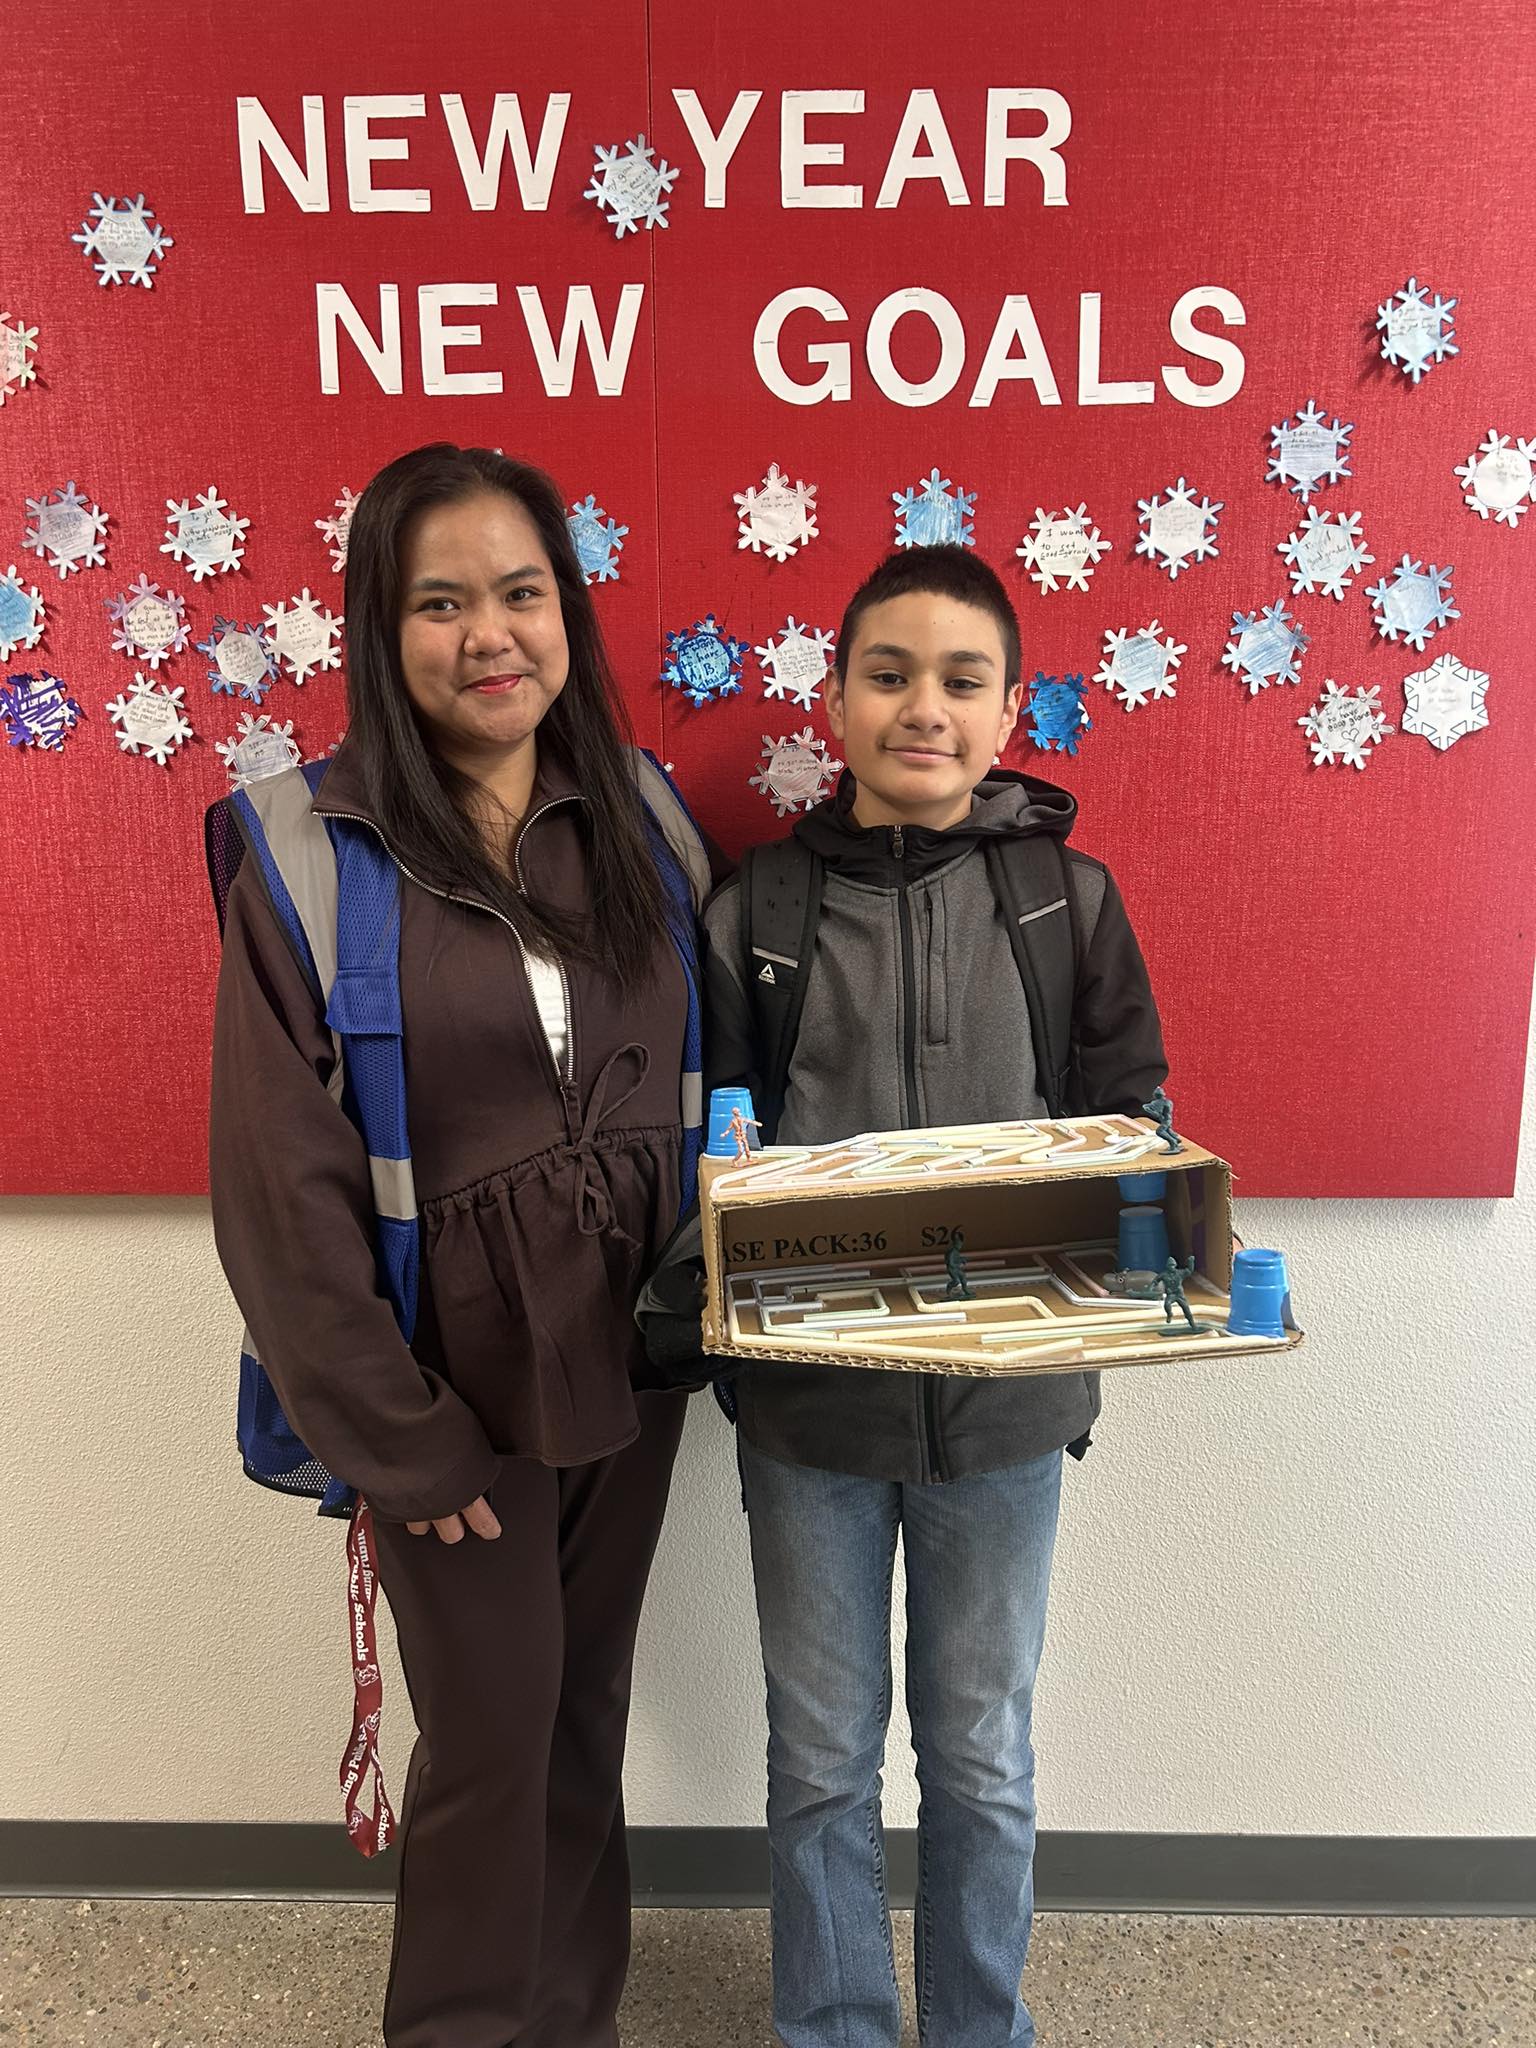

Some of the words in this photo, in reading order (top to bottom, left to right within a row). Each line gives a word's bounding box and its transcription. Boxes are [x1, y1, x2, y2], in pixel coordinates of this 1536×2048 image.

[237, 92, 571, 214] NEW
[672, 87, 1071, 209] YEAR
[316, 282, 644, 397] NEW
[753, 286, 1246, 407] GOALS
[1040, 543, 1052, 551] to
[1046, 528, 1053, 537] I
[1060, 525, 1084, 537] want
[691, 638, 716, 652] want
[680, 660, 694, 670] to
[773, 1230, 888, 1260] PACK:36
[920, 1225, 964, 1248] S26
[354, 1602, 369, 1661] Schools
[377, 1804, 391, 1852] Schools
